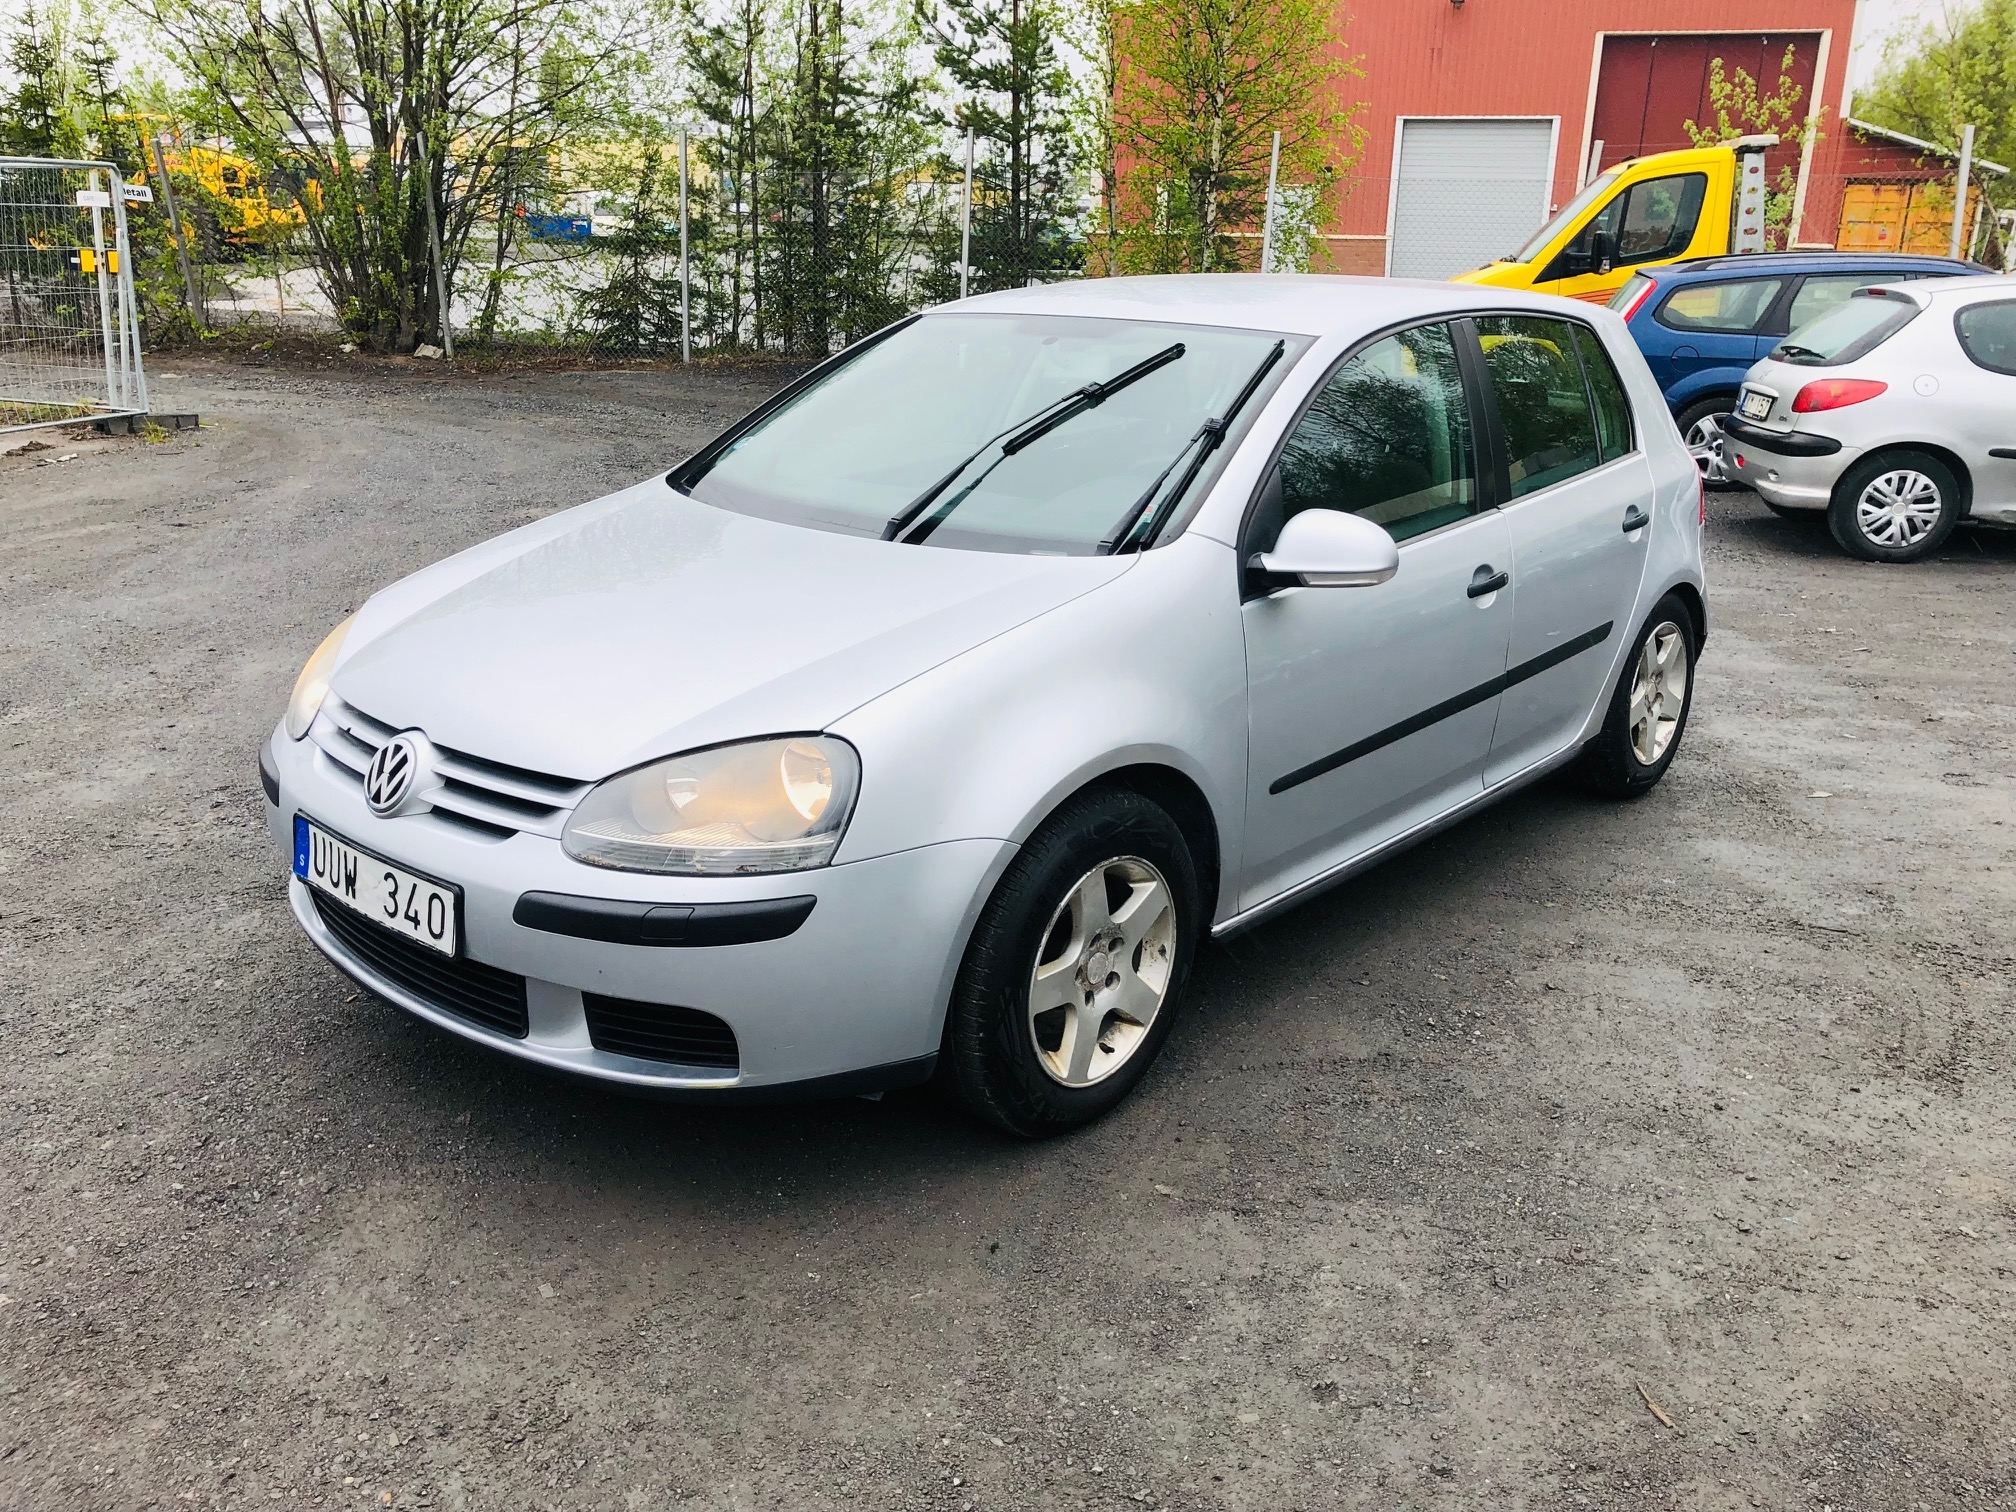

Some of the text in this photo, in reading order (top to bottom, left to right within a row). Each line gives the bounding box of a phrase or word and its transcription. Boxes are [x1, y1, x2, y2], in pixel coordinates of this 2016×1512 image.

[298, 853, 306, 867] S
[313, 831, 446, 940] UUW 340
